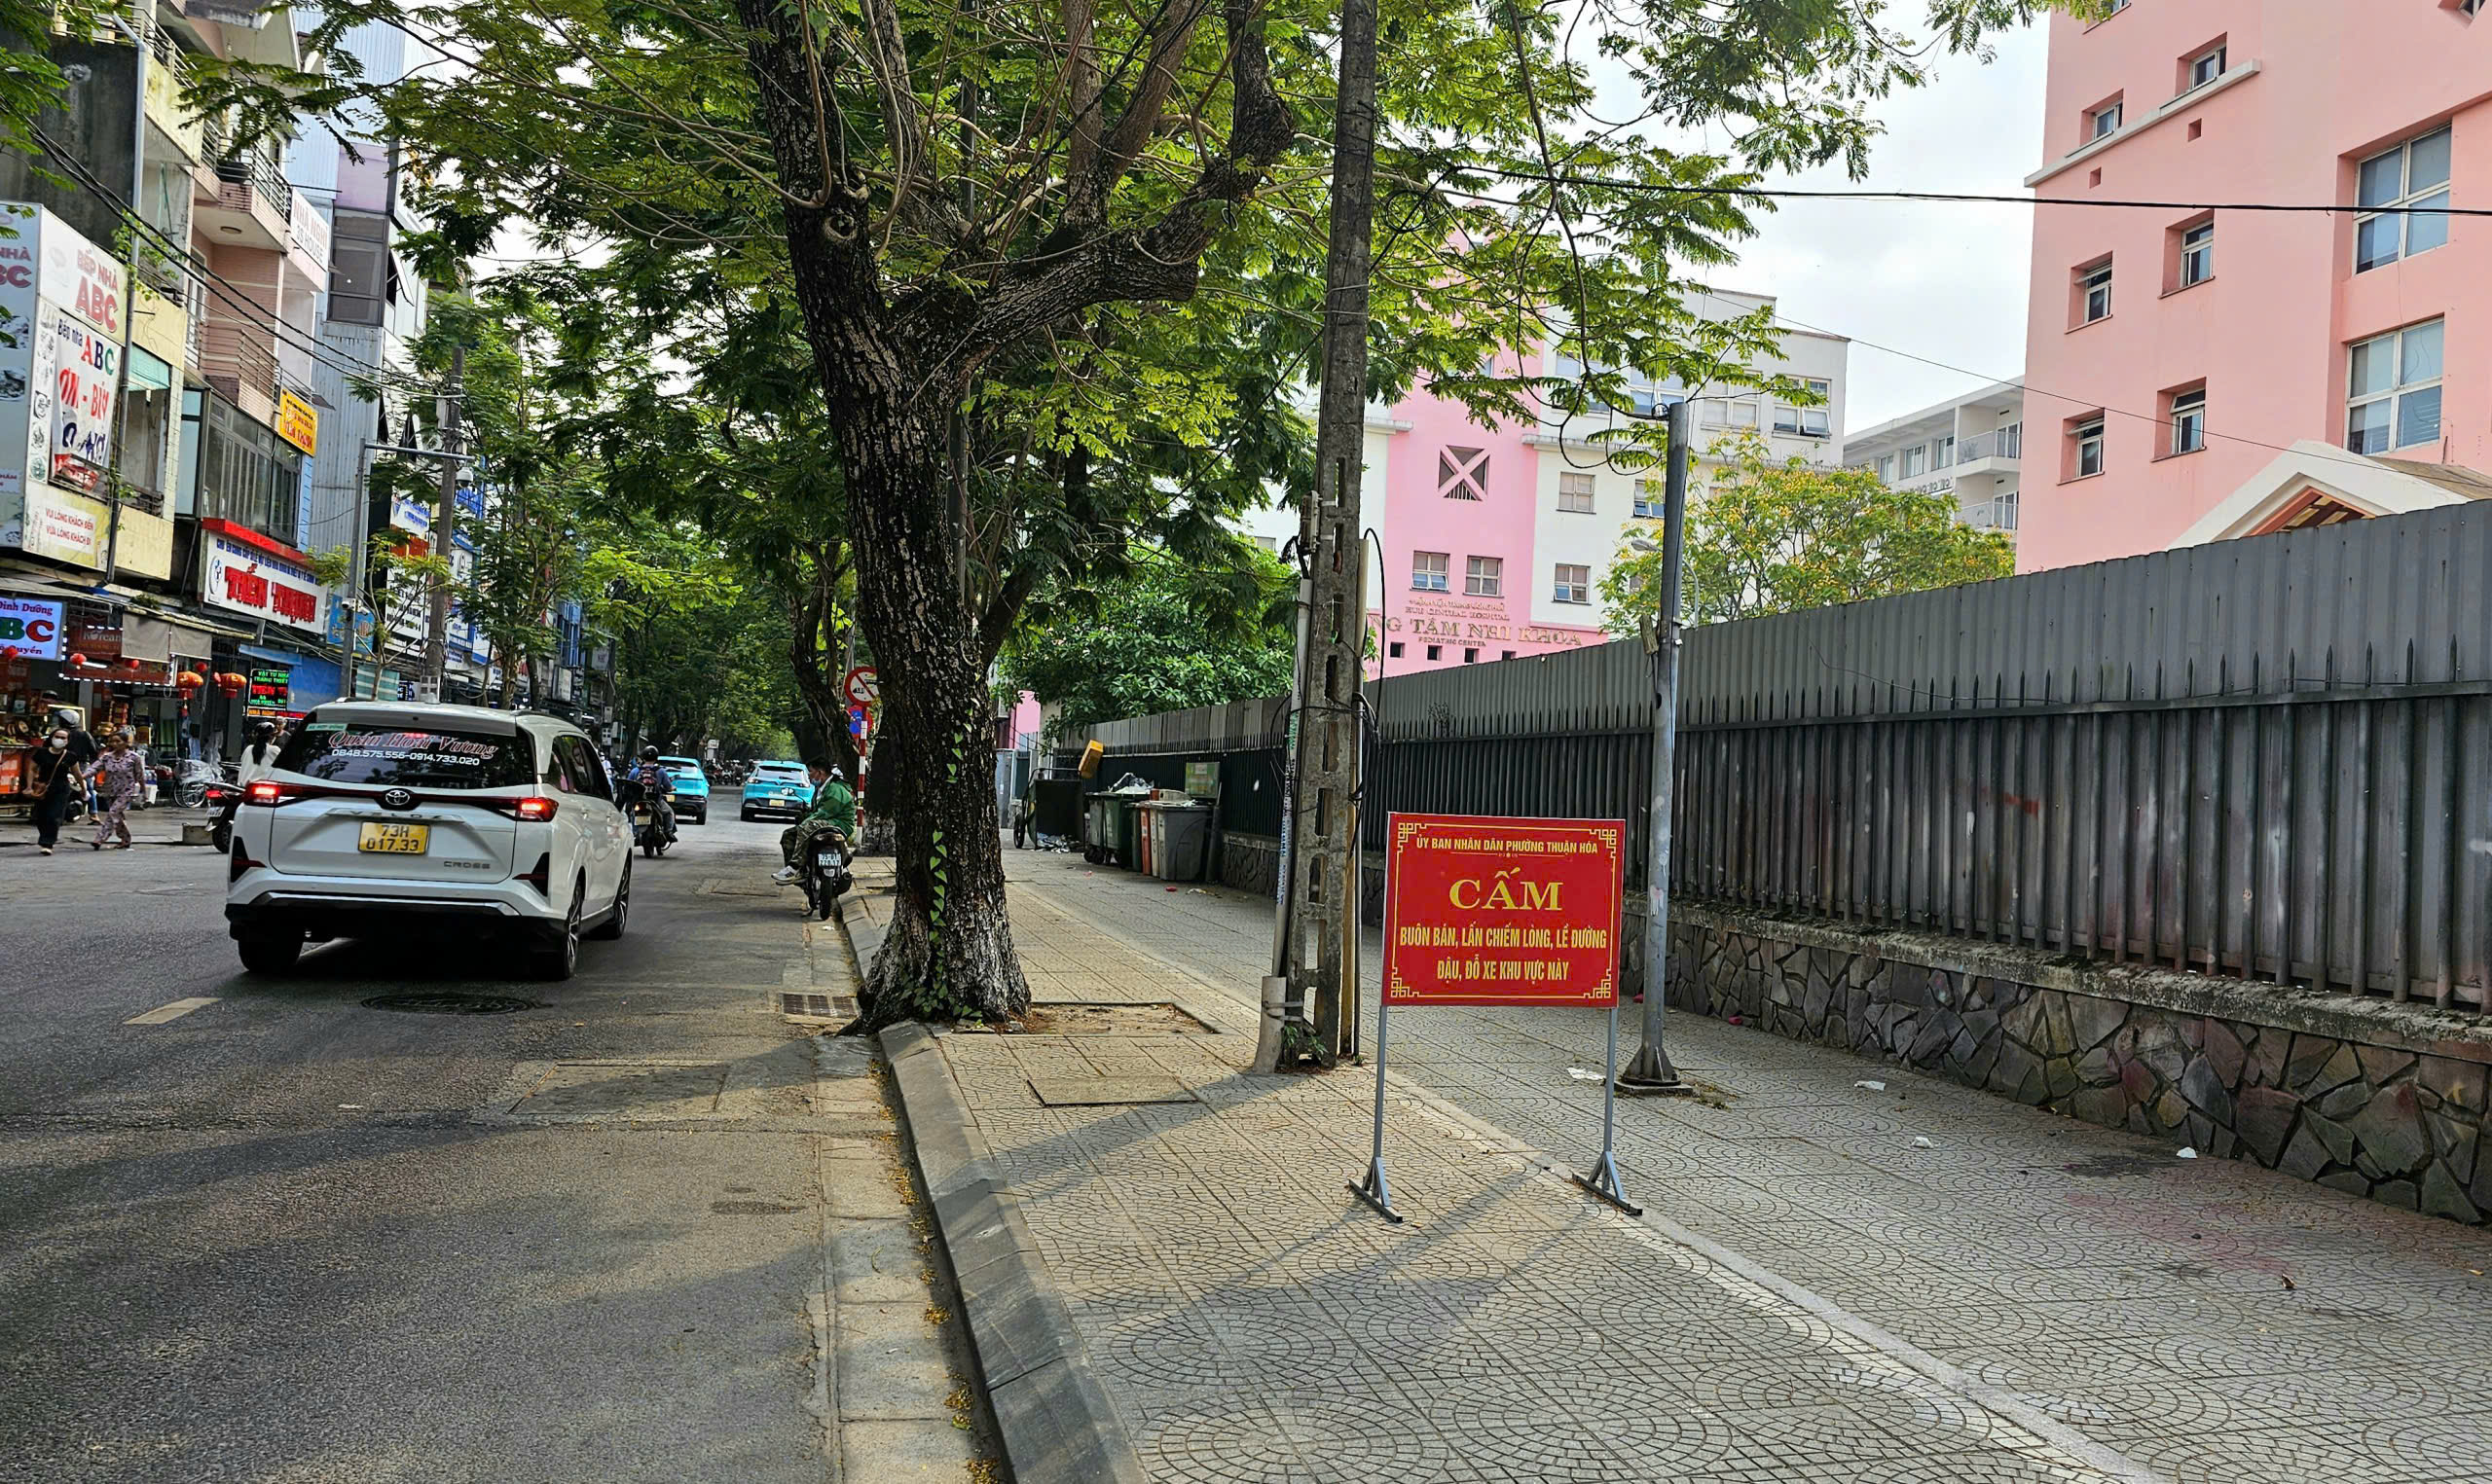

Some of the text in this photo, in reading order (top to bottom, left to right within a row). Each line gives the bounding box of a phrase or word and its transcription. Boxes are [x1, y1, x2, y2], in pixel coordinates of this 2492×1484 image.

[75, 274, 119, 334] ABC
[81, 334, 116, 377] ABC
[1518, 628, 1583, 646] KHOA
[328, 731, 383, 748] Quán
[381, 824, 410, 838] 73H
[366, 838, 420, 851] 017.33
[1431, 838, 1451, 850] BAN
[1454, 837, 1481, 851] NHÂN
[1484, 838, 1503, 851] DÂN
[1506, 838, 1544, 852] PHƯỜNG
[1547, 840, 1577, 855] THUẬN
[1579, 841, 1598, 853] HÓA
[443, 859, 491, 870] CROSS
[1449, 867, 1563, 911] CẤM
[1400, 923, 1430, 946] BUÔN
[1433, 923, 1458, 949] BÁN,
[1461, 921, 1483, 947] LẤN
[1485, 922, 1521, 947] CHIẾM
[1522, 923, 1554, 950] LÒNG,
[1571, 924, 1607, 949] ĐƯỜNG
[1437, 954, 1569, 985] ĐẬU, ĐỖ XE KHU VỰC NÀY
